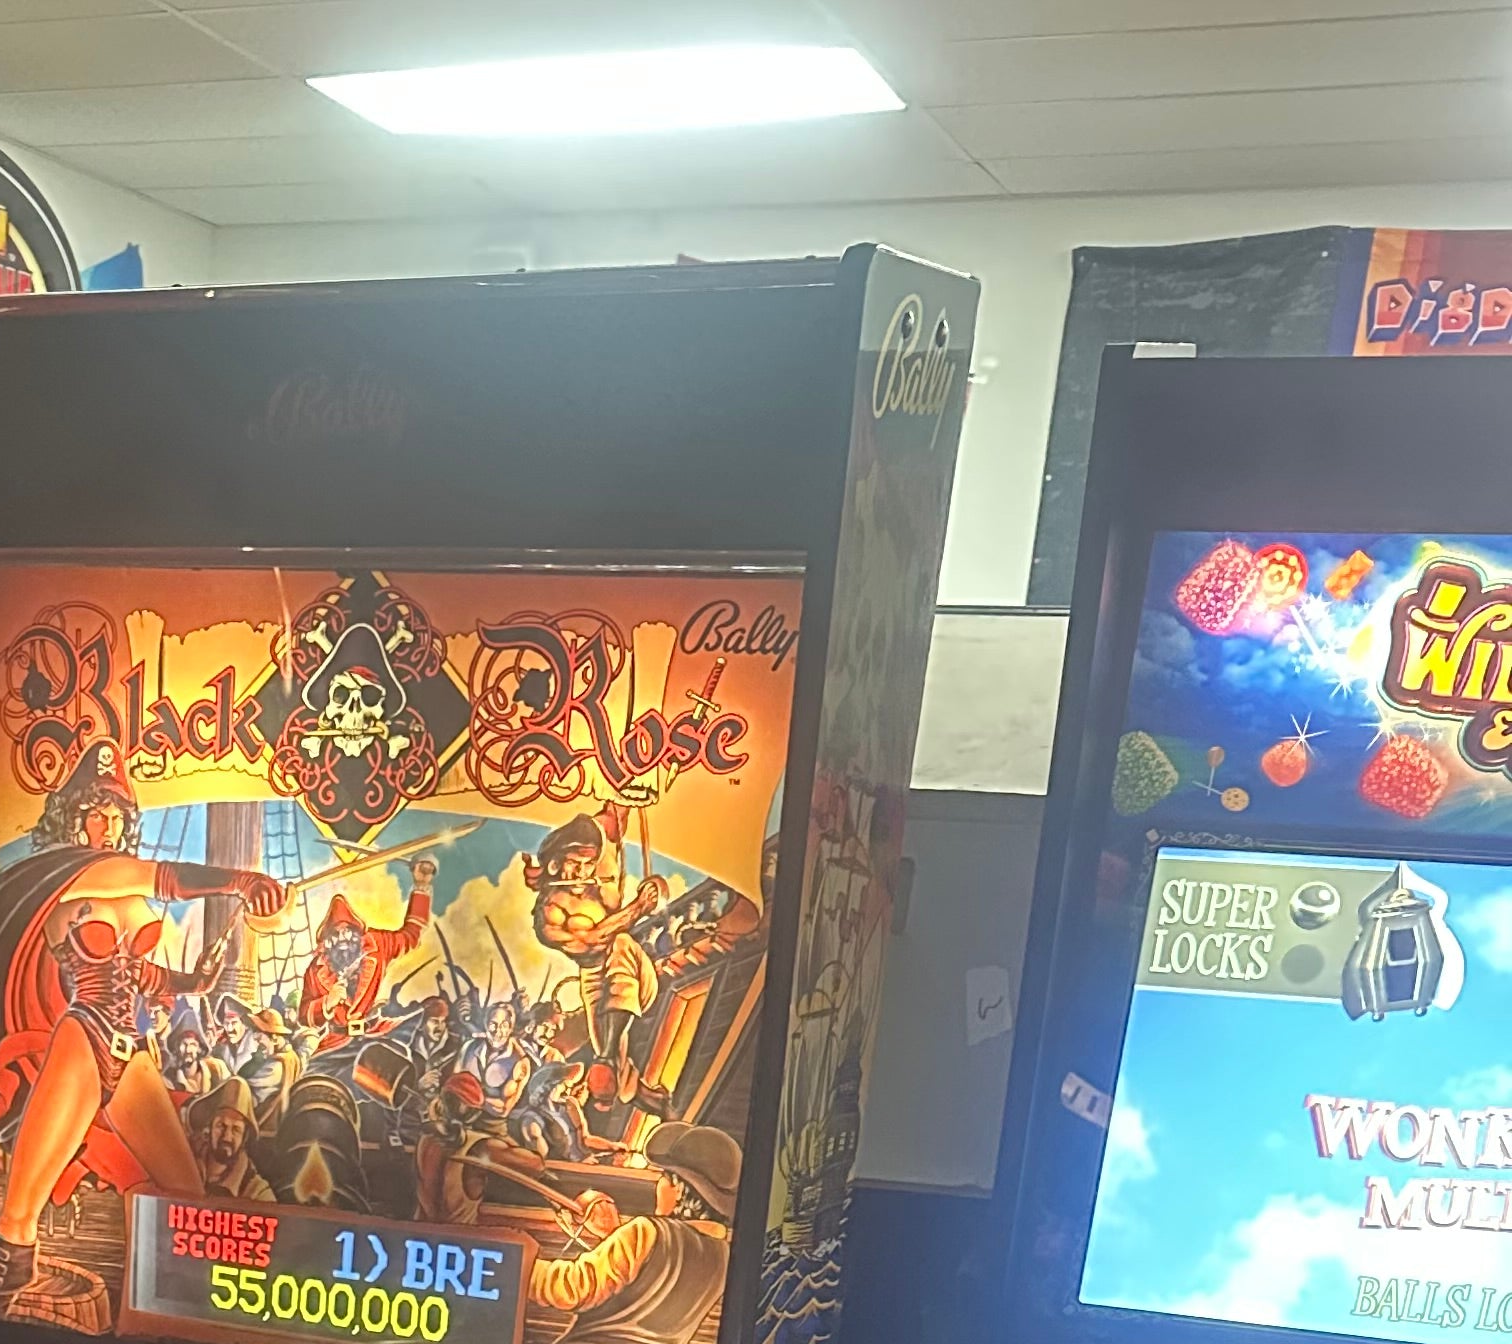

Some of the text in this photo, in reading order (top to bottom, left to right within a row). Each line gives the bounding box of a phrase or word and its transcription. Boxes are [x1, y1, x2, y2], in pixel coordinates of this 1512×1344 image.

[873, 293, 956, 451] Bally
[682, 599, 800, 672] Bally
[3, 610, 751, 795] Black Rose
[1158, 878, 1280, 931] SUPER
[1149, 928, 1275, 982] LOCKS
[168, 1204, 279, 1243] HIGHEST
[172, 1232, 272, 1268] SCORES
[402, 1239, 503, 1301] BRE
[210, 1264, 450, 1343] 55,000,000
[1350, 1275, 1472, 1329] BALLS
